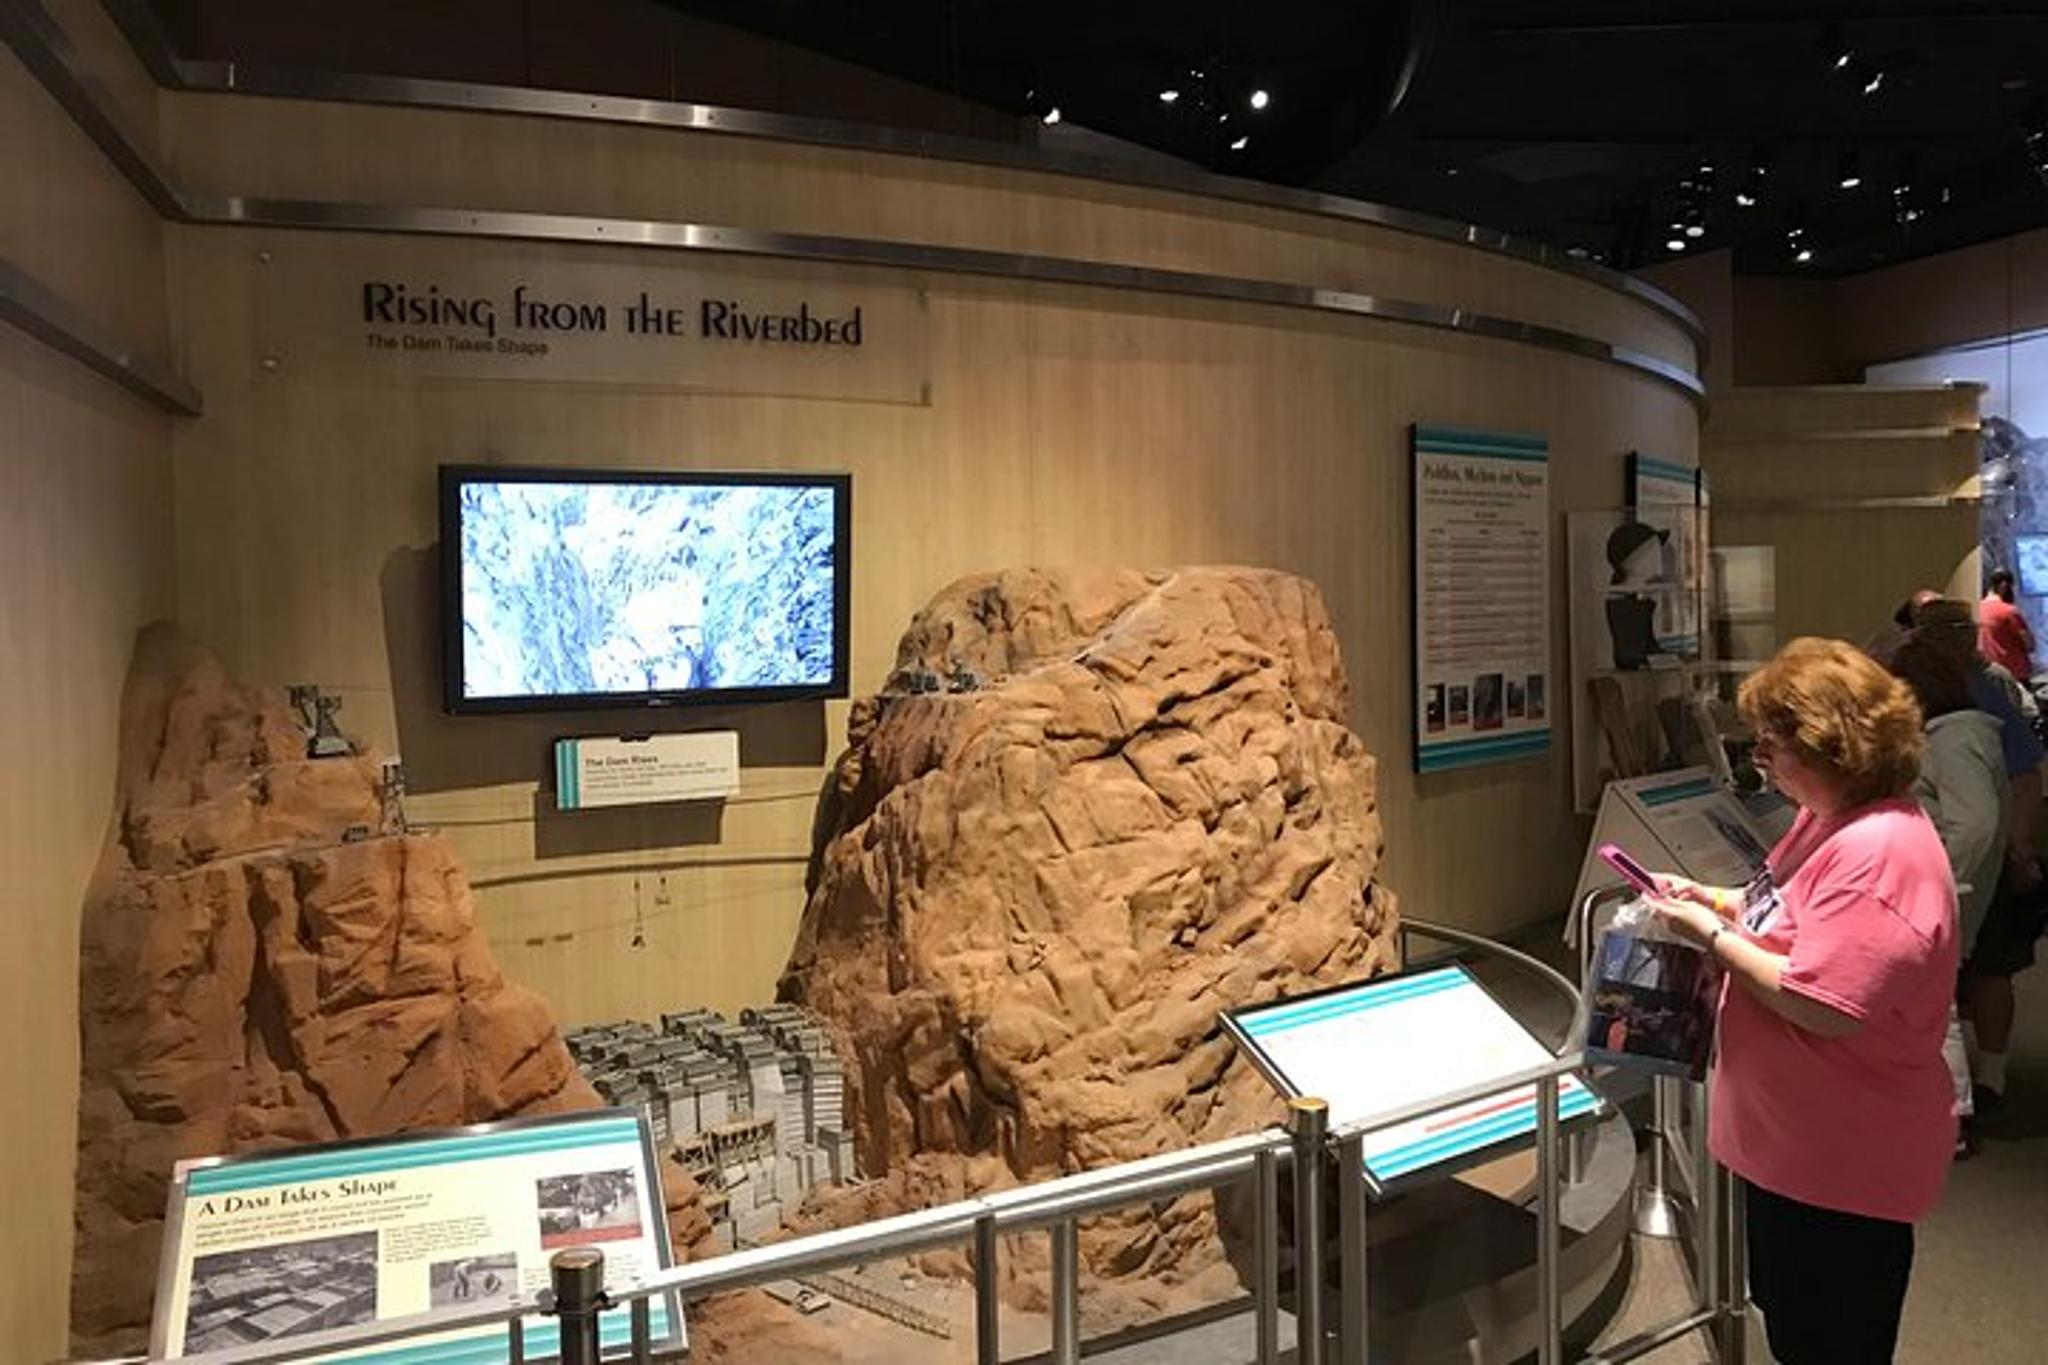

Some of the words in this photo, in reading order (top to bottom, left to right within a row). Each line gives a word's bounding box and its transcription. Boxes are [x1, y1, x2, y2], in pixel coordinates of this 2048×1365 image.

[367, 333, 398, 349] The
[403, 334, 441, 350] Dam
[447, 335, 493, 352] Takes
[498, 337, 548, 356] Shape
[585, 758, 603, 766] The
[198, 1200, 215, 1217] A
